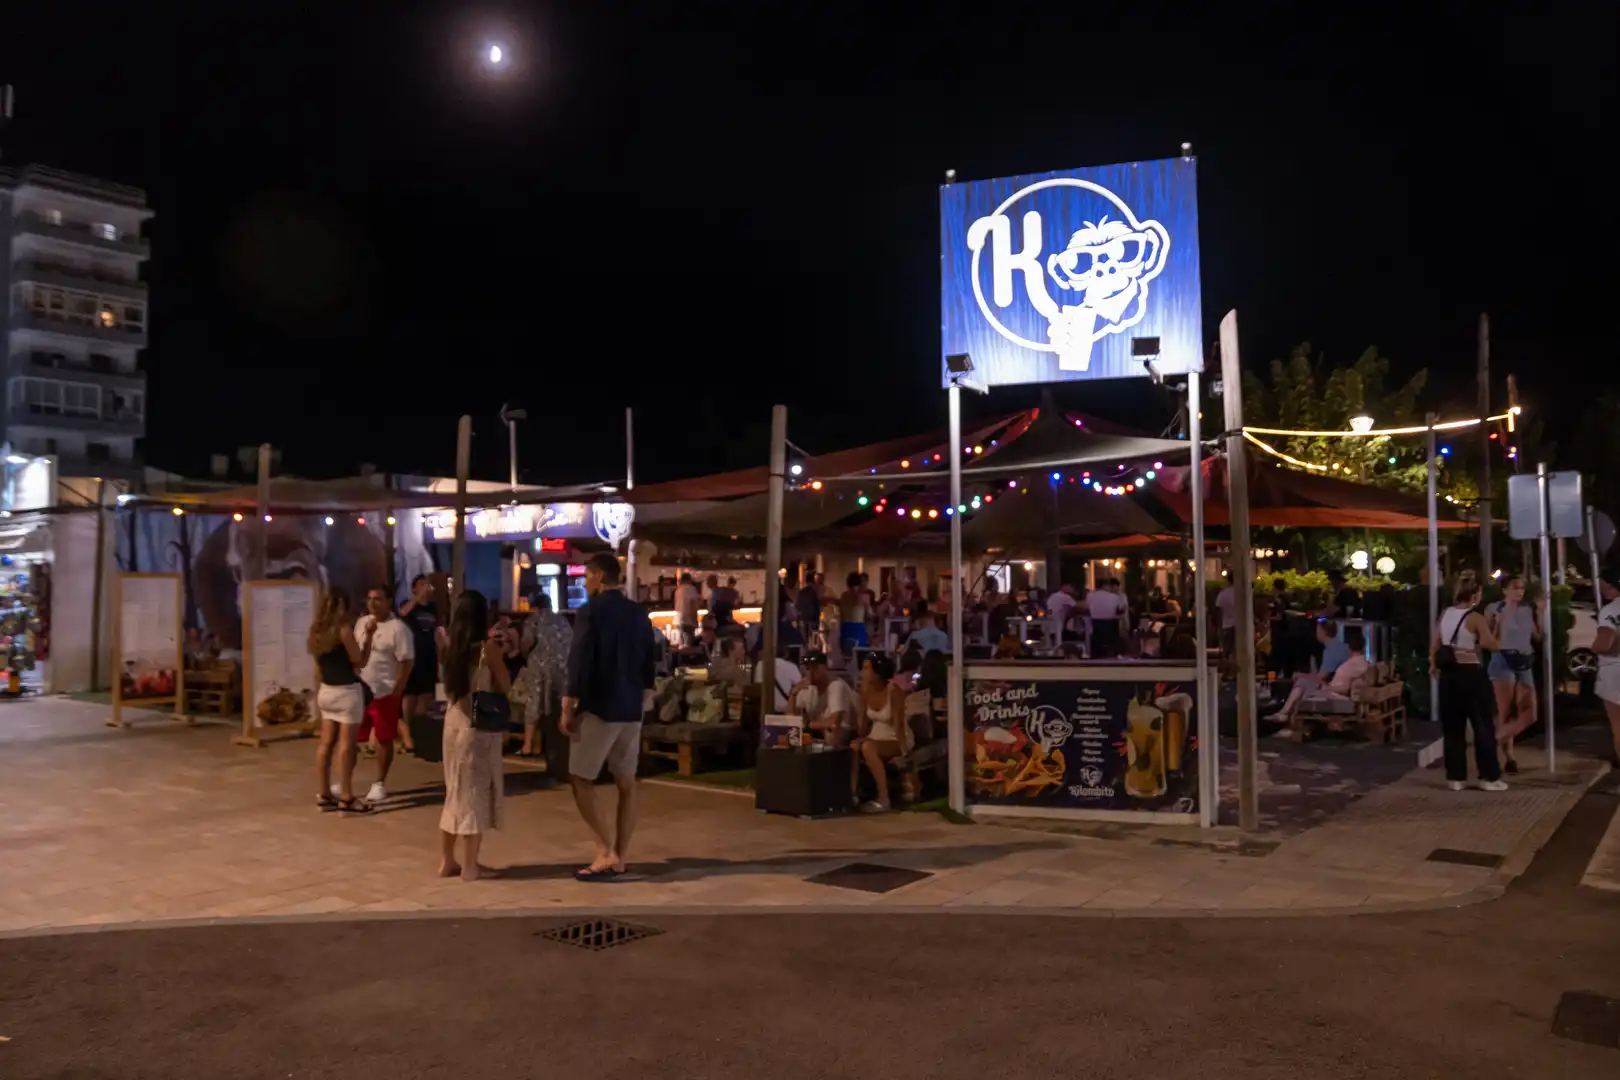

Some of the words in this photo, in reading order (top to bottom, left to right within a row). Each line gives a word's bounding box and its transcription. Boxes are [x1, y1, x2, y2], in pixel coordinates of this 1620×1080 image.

[967, 211, 1058, 318] K
[965, 688, 1003, 705] Food
[1006, 683, 1039, 700] and
[978, 703, 1030, 721] Drinks
